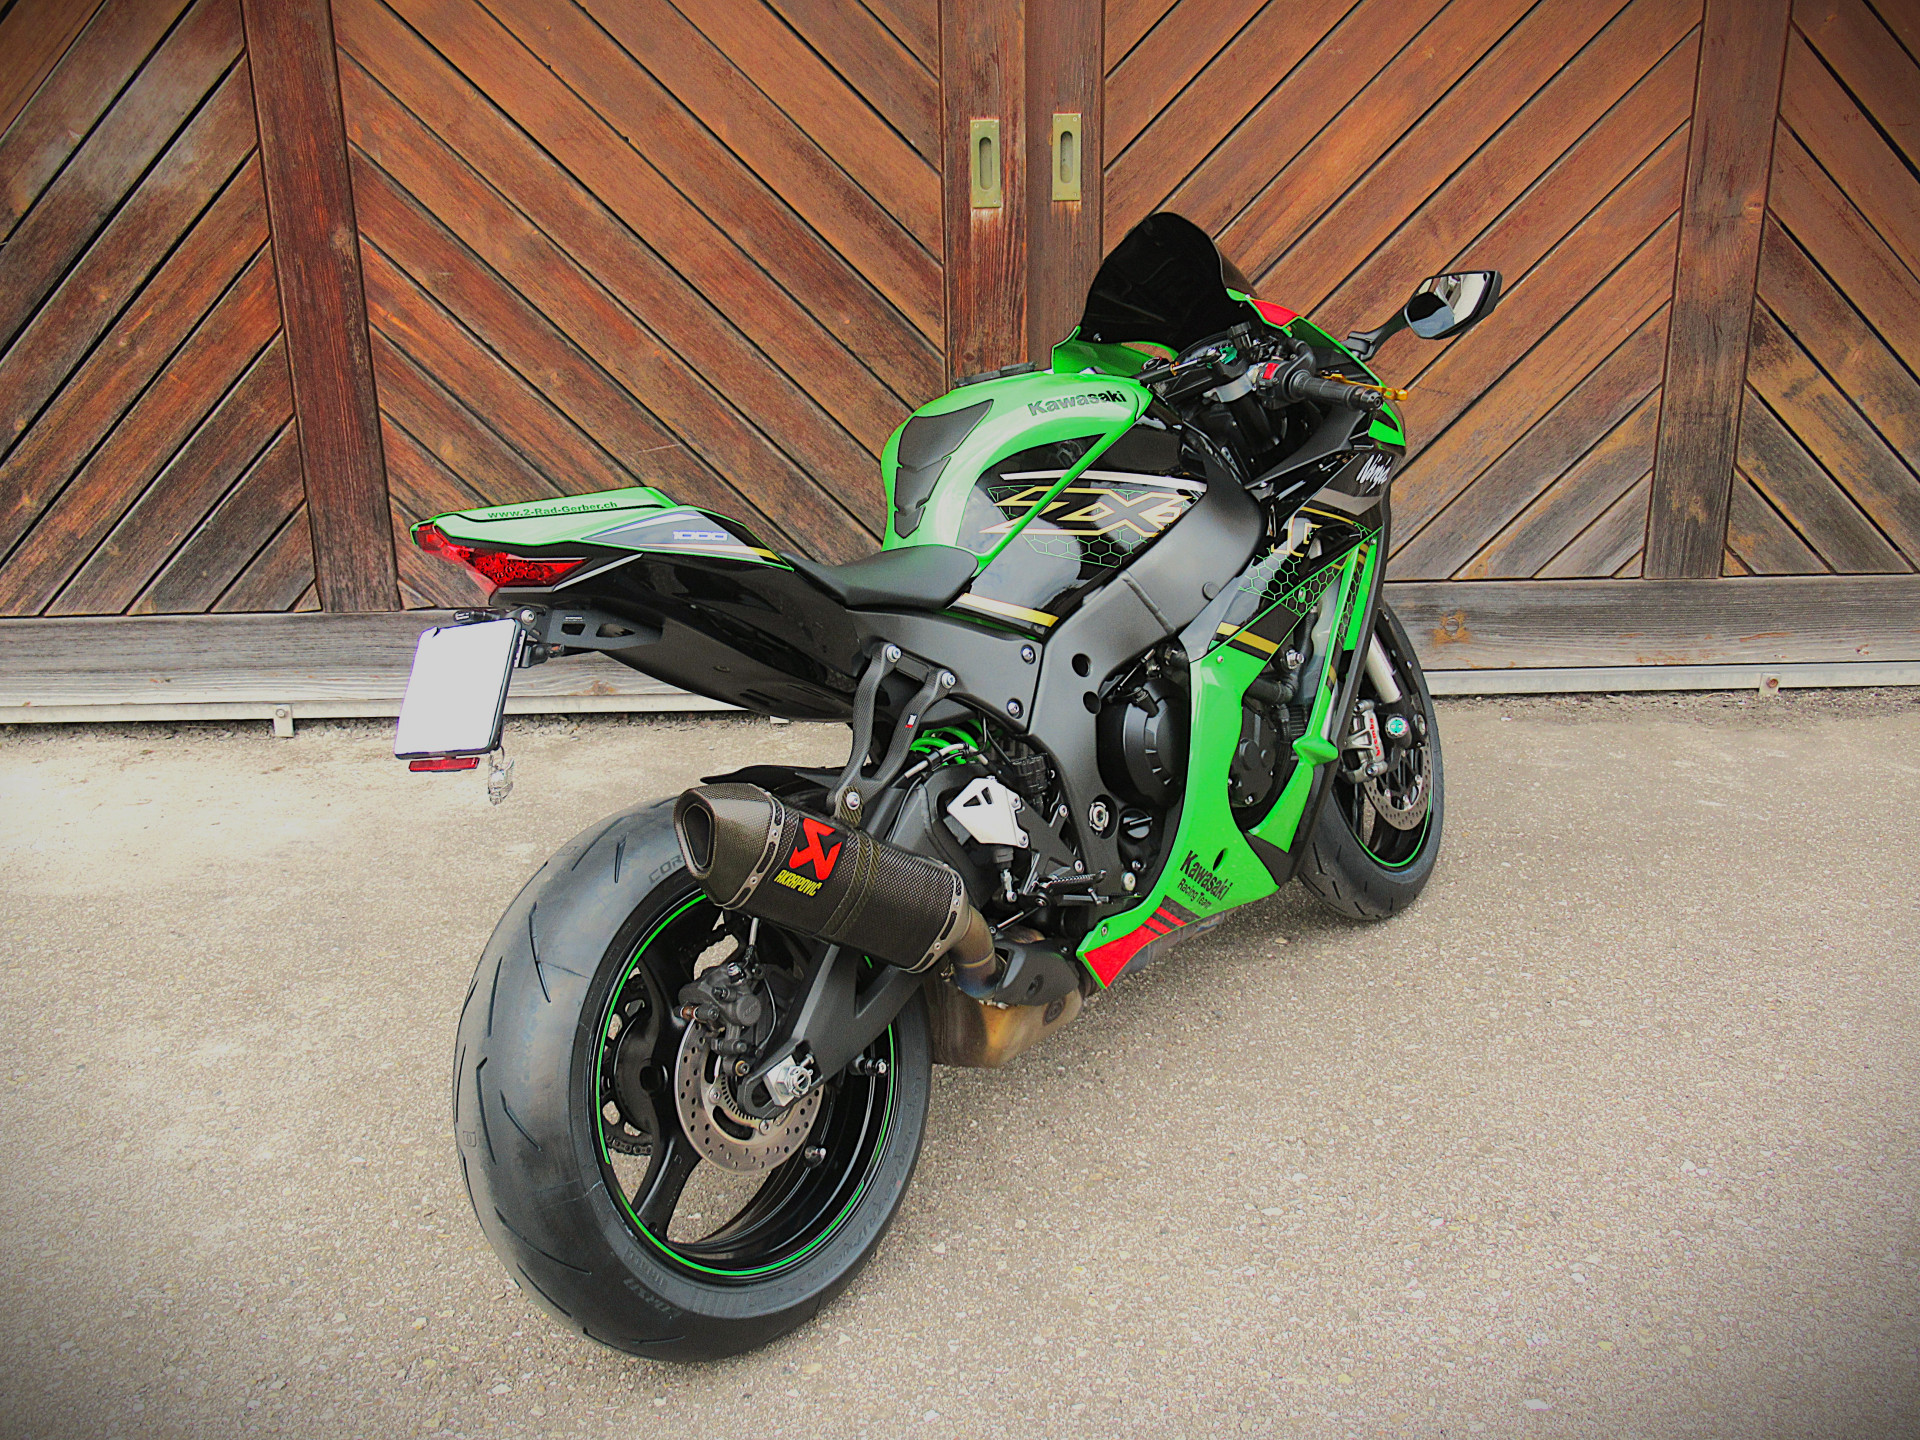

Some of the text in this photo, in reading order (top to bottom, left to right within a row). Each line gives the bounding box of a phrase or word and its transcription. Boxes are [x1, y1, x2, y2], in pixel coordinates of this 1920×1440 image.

[1027, 390, 1127, 416] Kawasaki
[488, 502, 618, 519] www.2-Rad-Gerber.ch
[648, 854, 683, 884] COR
[1180, 850, 1233, 901] Kawasaki
[1177, 877, 1212, 909] Racing Team
